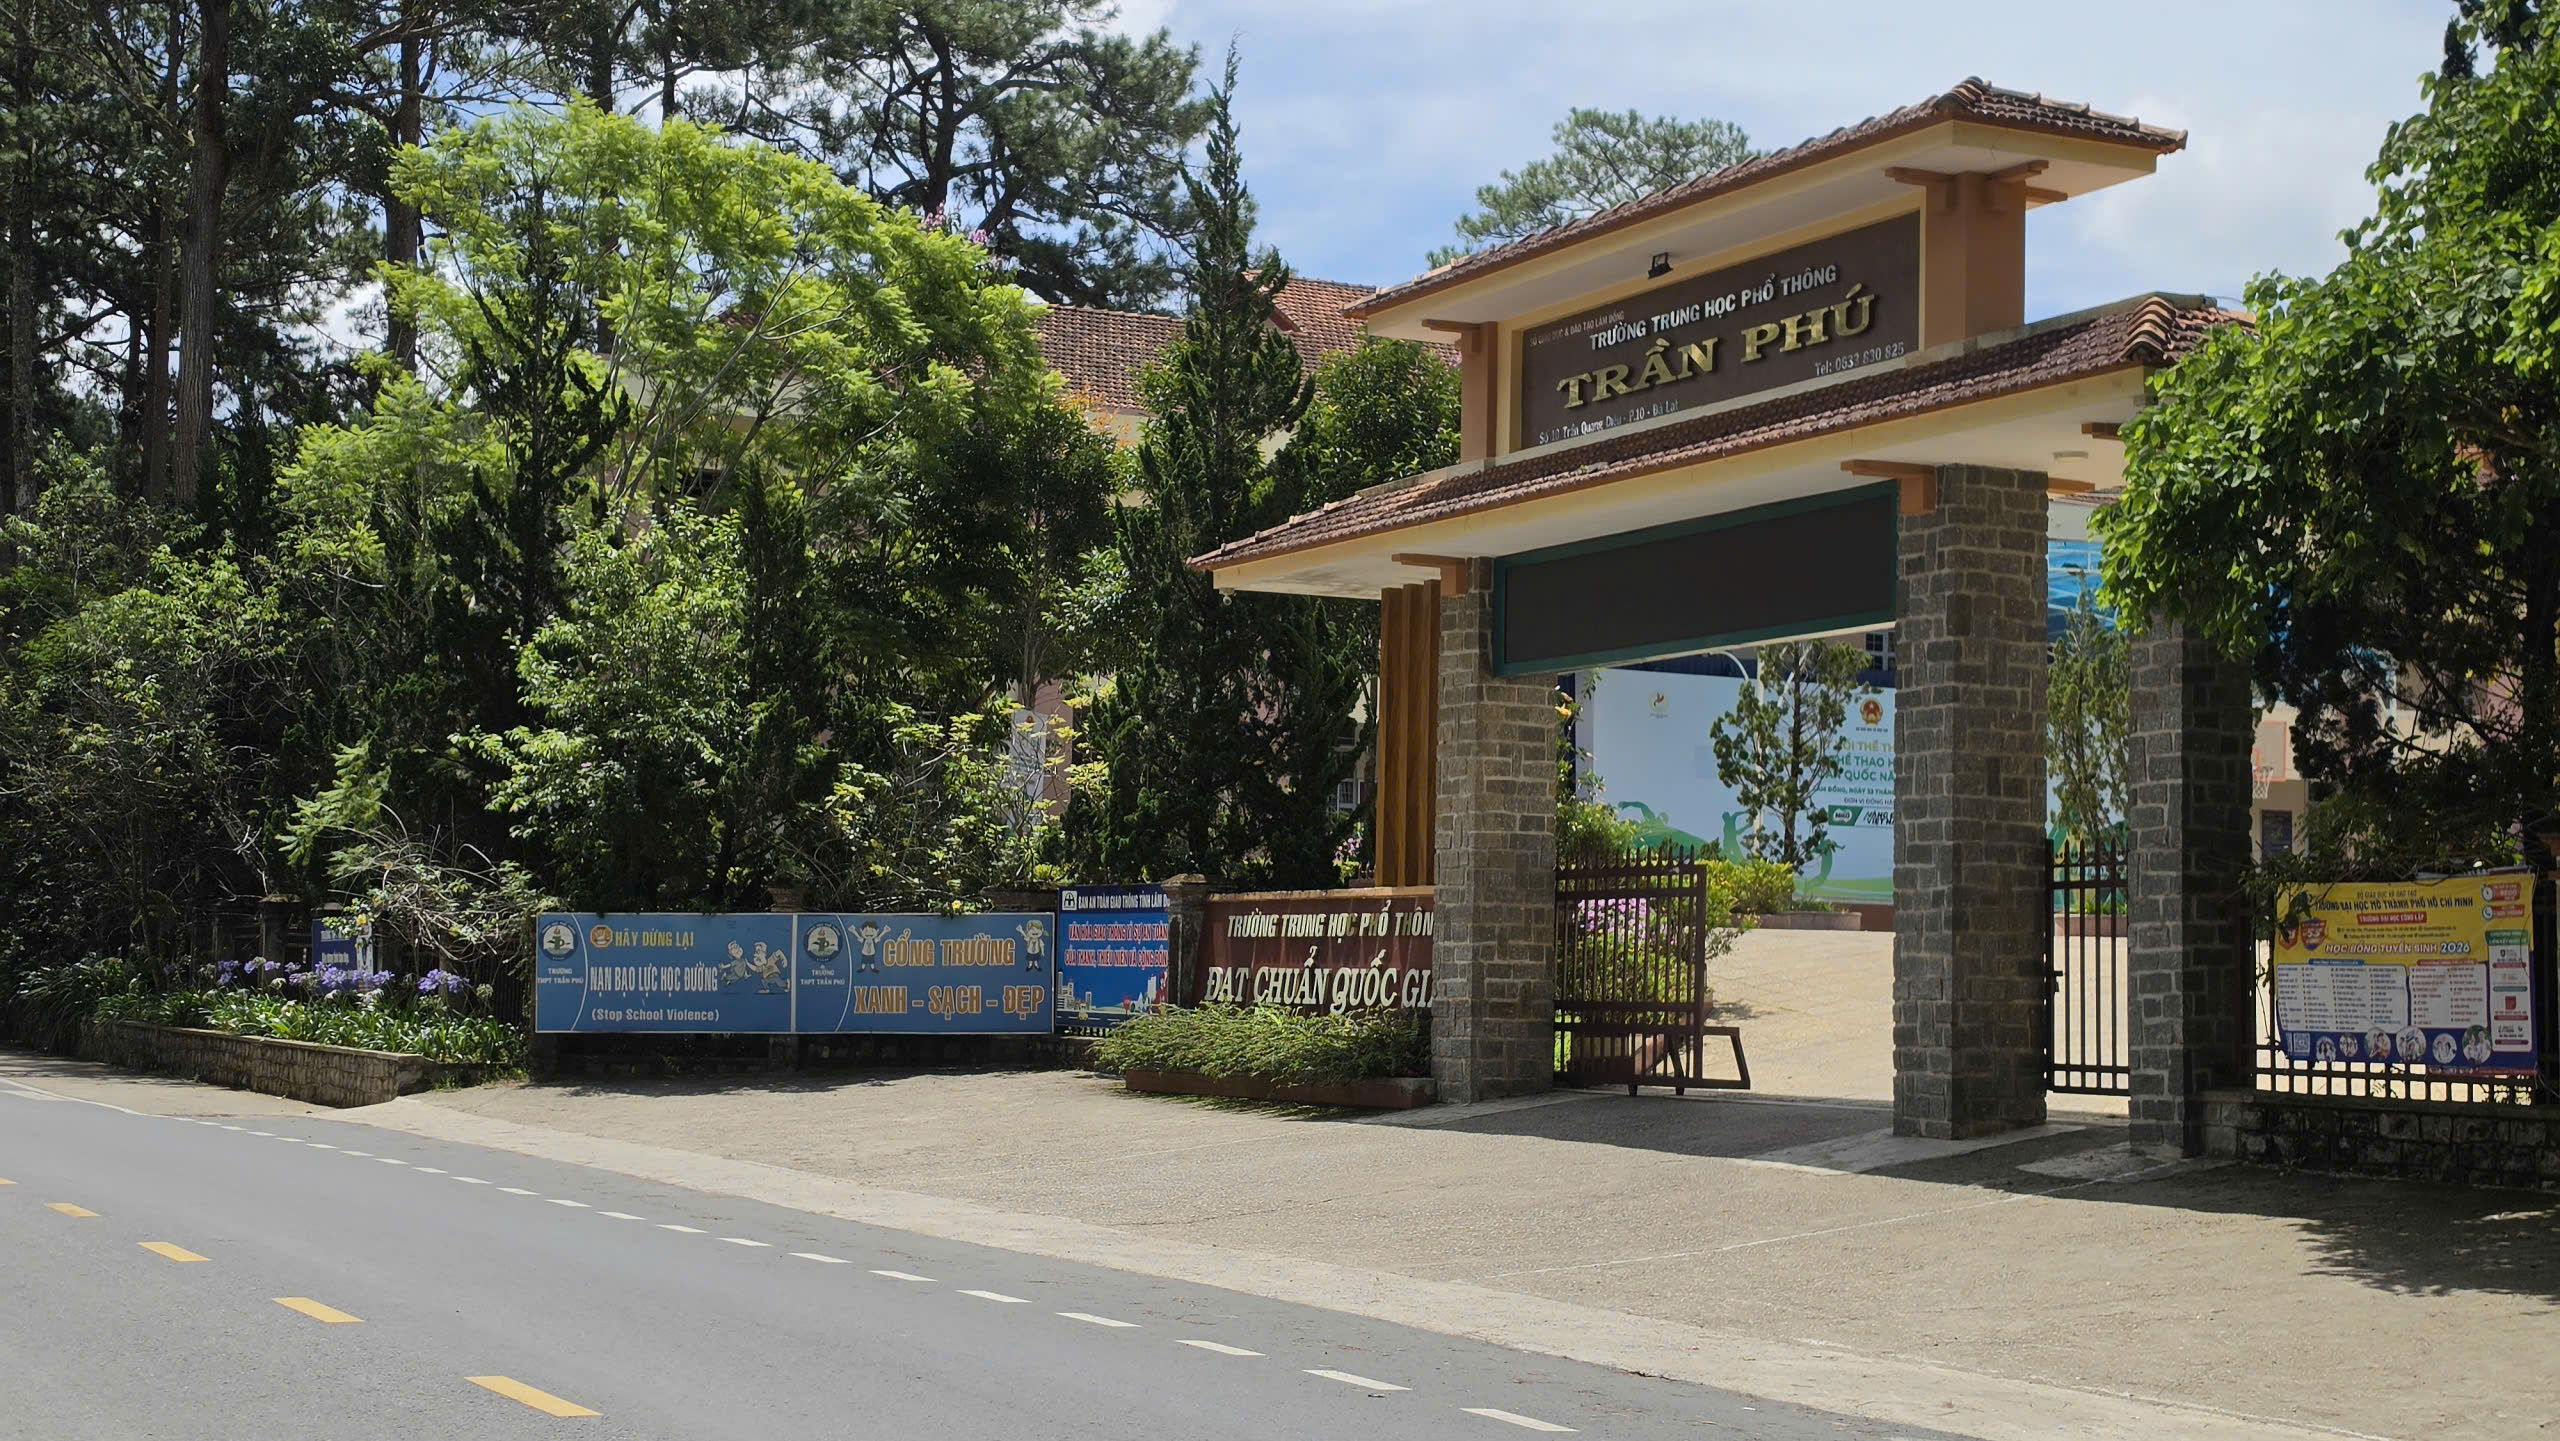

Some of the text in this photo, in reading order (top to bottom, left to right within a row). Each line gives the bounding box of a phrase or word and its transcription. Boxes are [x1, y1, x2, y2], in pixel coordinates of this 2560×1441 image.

[1590, 264, 1837, 351] TRƯỜNG TRUNG HỌC PHỔ THÔNG
[1556, 283, 1875, 409] TRẦN PHÚ
[1844, 768, 1877, 782] QUỐC
[1854, 756, 1885, 767] THAO
[2455, 897, 2473, 908] MINH
[1227, 900, 1434, 944] TRƯỜNG TRUNG HỌC PHỔ THÔN
[616, 928, 639, 947] HÃY
[676, 932, 695, 951] LẠI
[883, 928, 1016, 967] CỔNG TRƯỜNG
[2440, 942, 2472, 954] 2026
[1155, 944, 1169, 967] ĐỒN
[591, 961, 718, 998] NẠN BẠO LỰC HỌC ĐƯỜNG
[1253, 946, 1332, 1005] CHUẨN
[1330, 949, 1398, 1015] QUỐC
[1402, 969, 1434, 1008] GI
[592, 1009, 720, 1022] (Stop School Violence)
[854, 985, 908, 1015] XANH
[928, 985, 982, 1021] SẠCH
[1003, 985, 1045, 1021] ĐẸP
